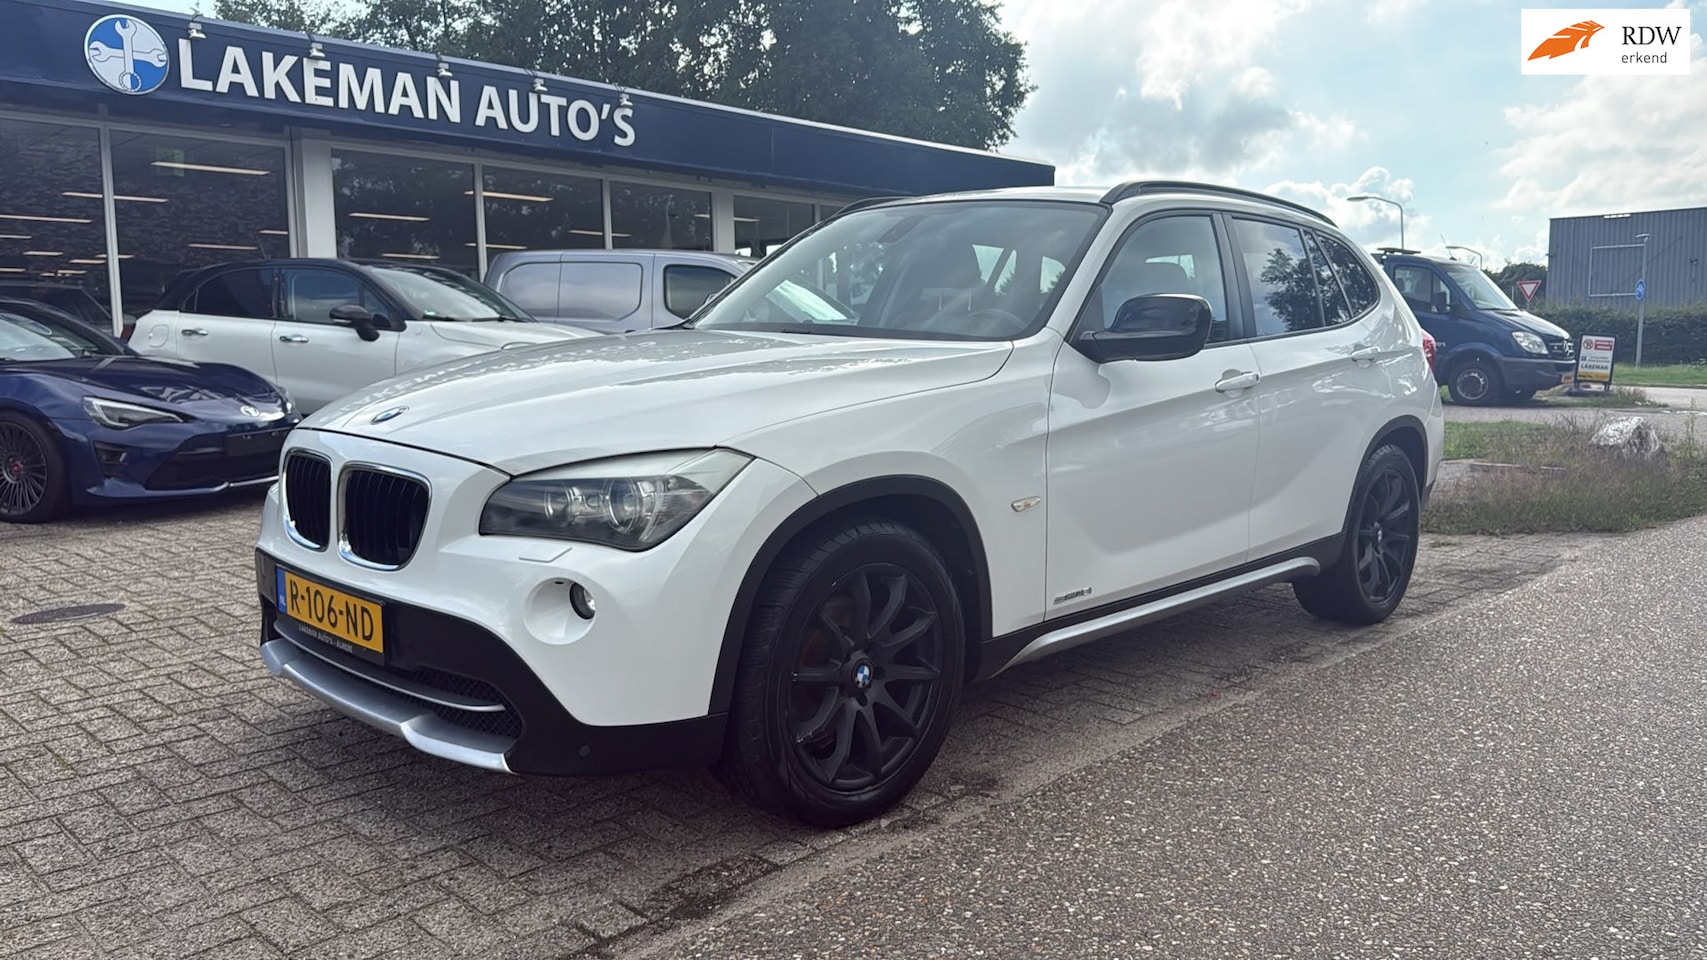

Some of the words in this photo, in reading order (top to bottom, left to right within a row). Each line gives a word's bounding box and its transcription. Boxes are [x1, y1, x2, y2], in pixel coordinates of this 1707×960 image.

[178, 38, 461, 124] LAKEMAN
[475, 85, 636, 147] AUTO'S
[289, 579, 374, 642] R-106-ND
